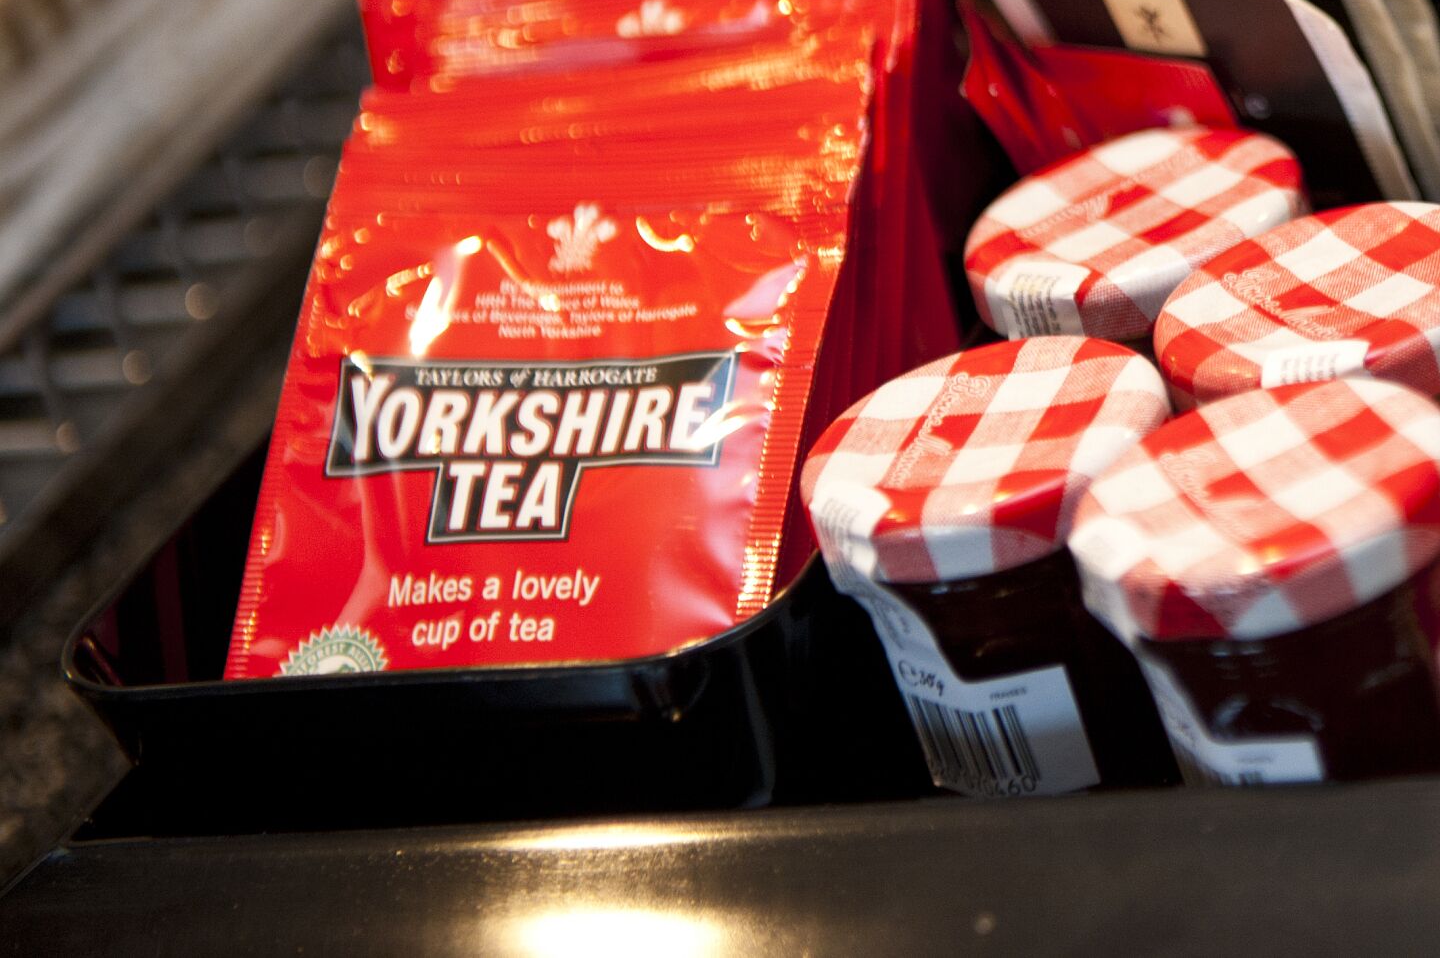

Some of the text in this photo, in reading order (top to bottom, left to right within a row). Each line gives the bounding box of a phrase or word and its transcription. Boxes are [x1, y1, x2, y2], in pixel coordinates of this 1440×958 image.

[414, 368, 503, 387] TAYLORS
[531, 366, 659, 388] HARROGATE
[350, 374, 714, 462] YORKSHIRE
[446, 462, 562, 532] TEA
[388, 568, 600, 607] Makes a lovely
[411, 612, 555, 649] cup of tea
